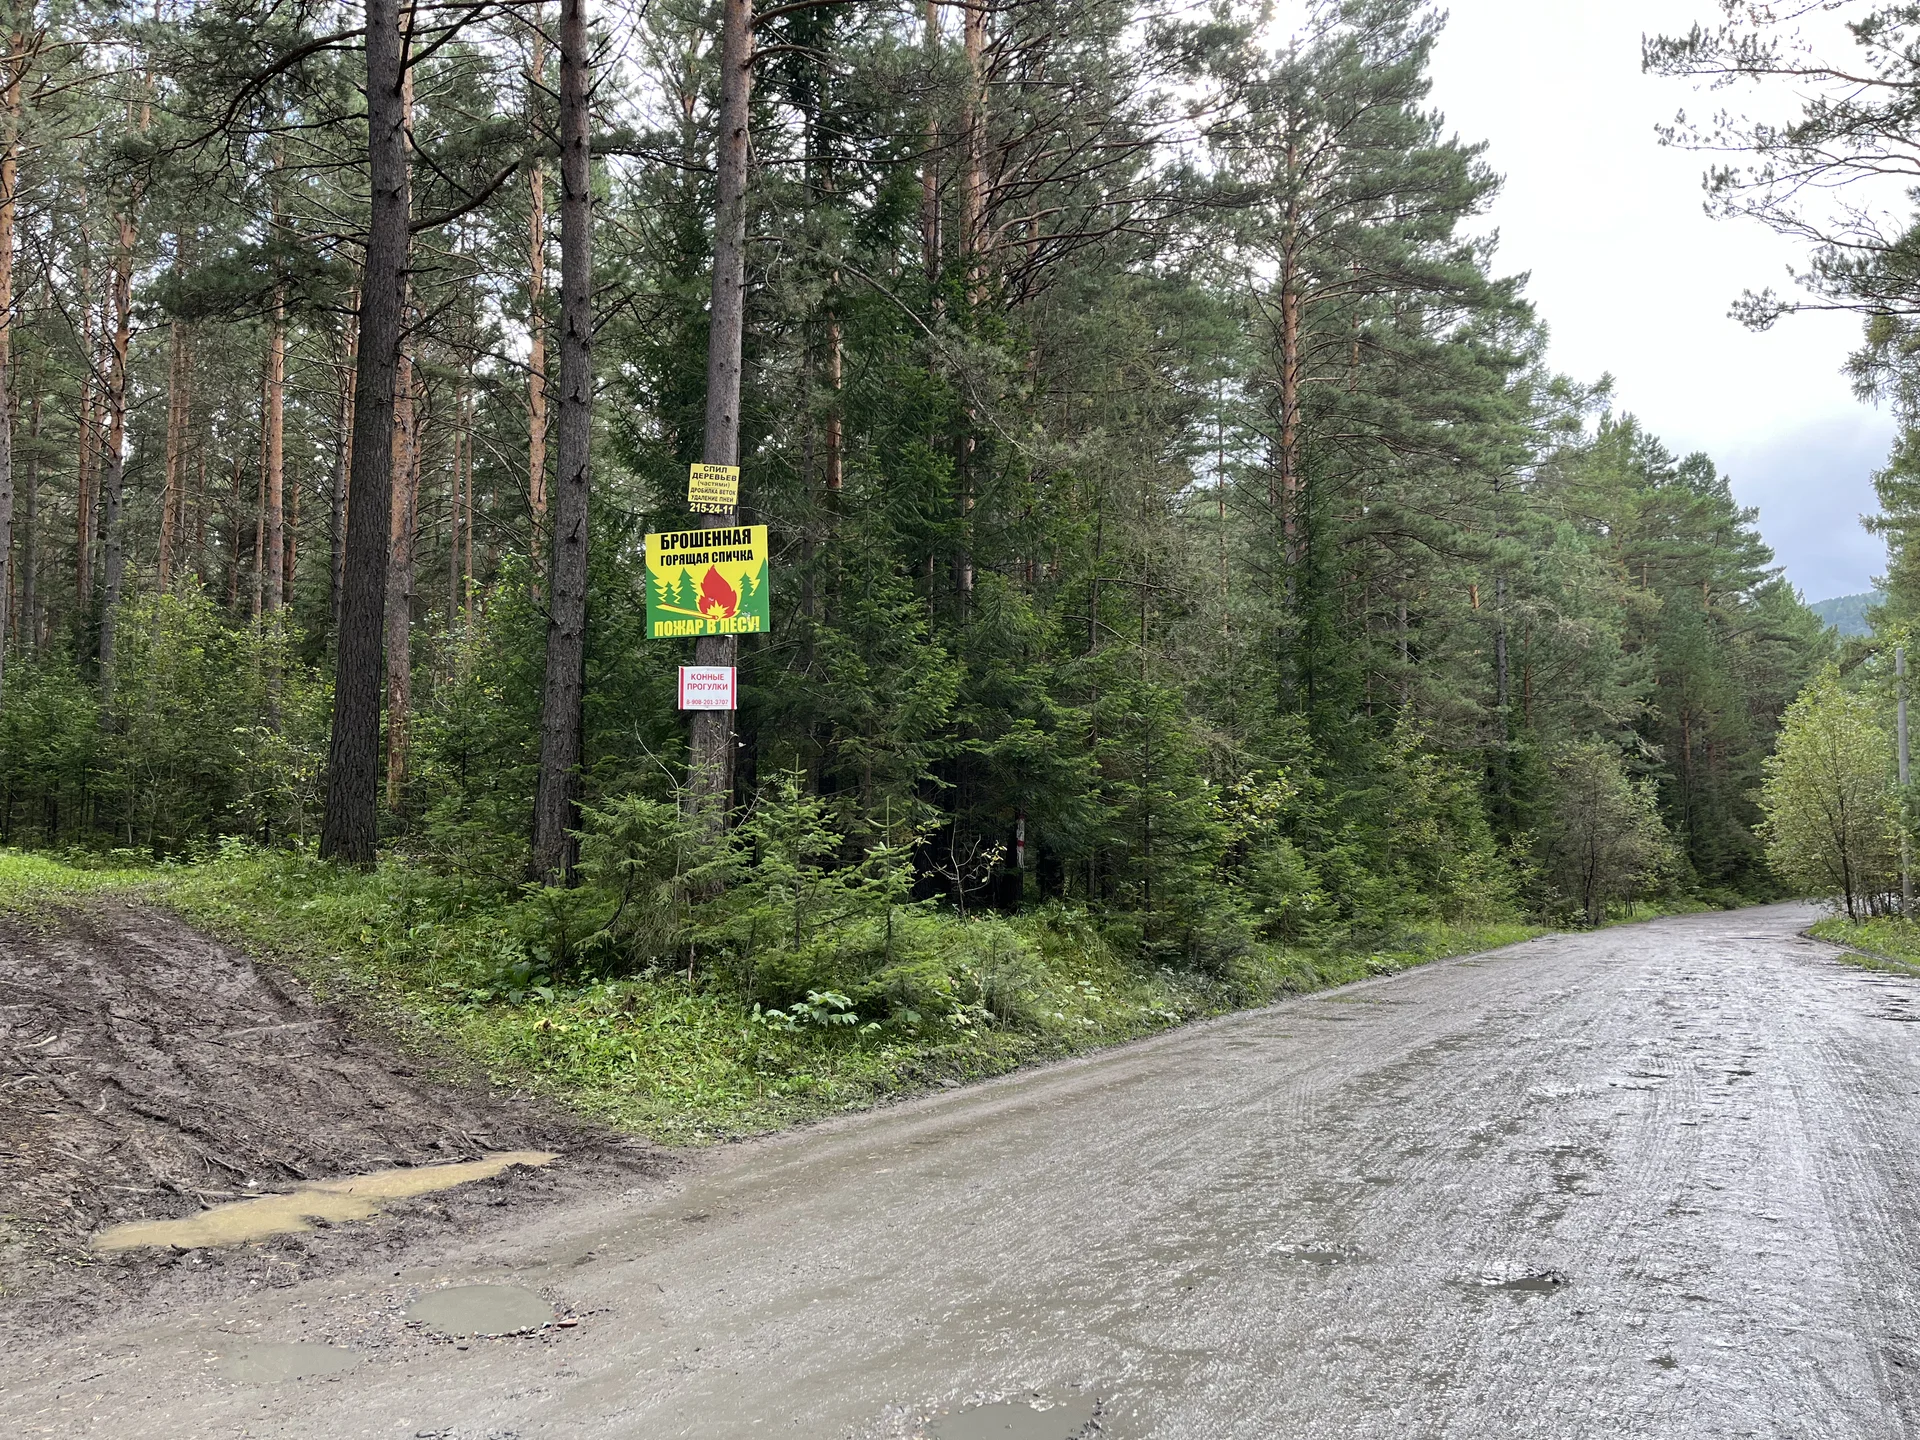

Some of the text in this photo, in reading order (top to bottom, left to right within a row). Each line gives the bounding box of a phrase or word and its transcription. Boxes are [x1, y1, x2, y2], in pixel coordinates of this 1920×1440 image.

[692, 472, 736, 481] ДЕРЕВЬЕВ
[698, 480, 730, 488] (частями)
[690, 503, 734, 514] 215-24-11
[660, 528, 752, 550] БРОШЕННАЯ
[660, 550, 754, 566] ГОРЯЩАЯ СПИЧКА
[654, 616, 760, 636] ПОЖАР В ЛЕСУ!
